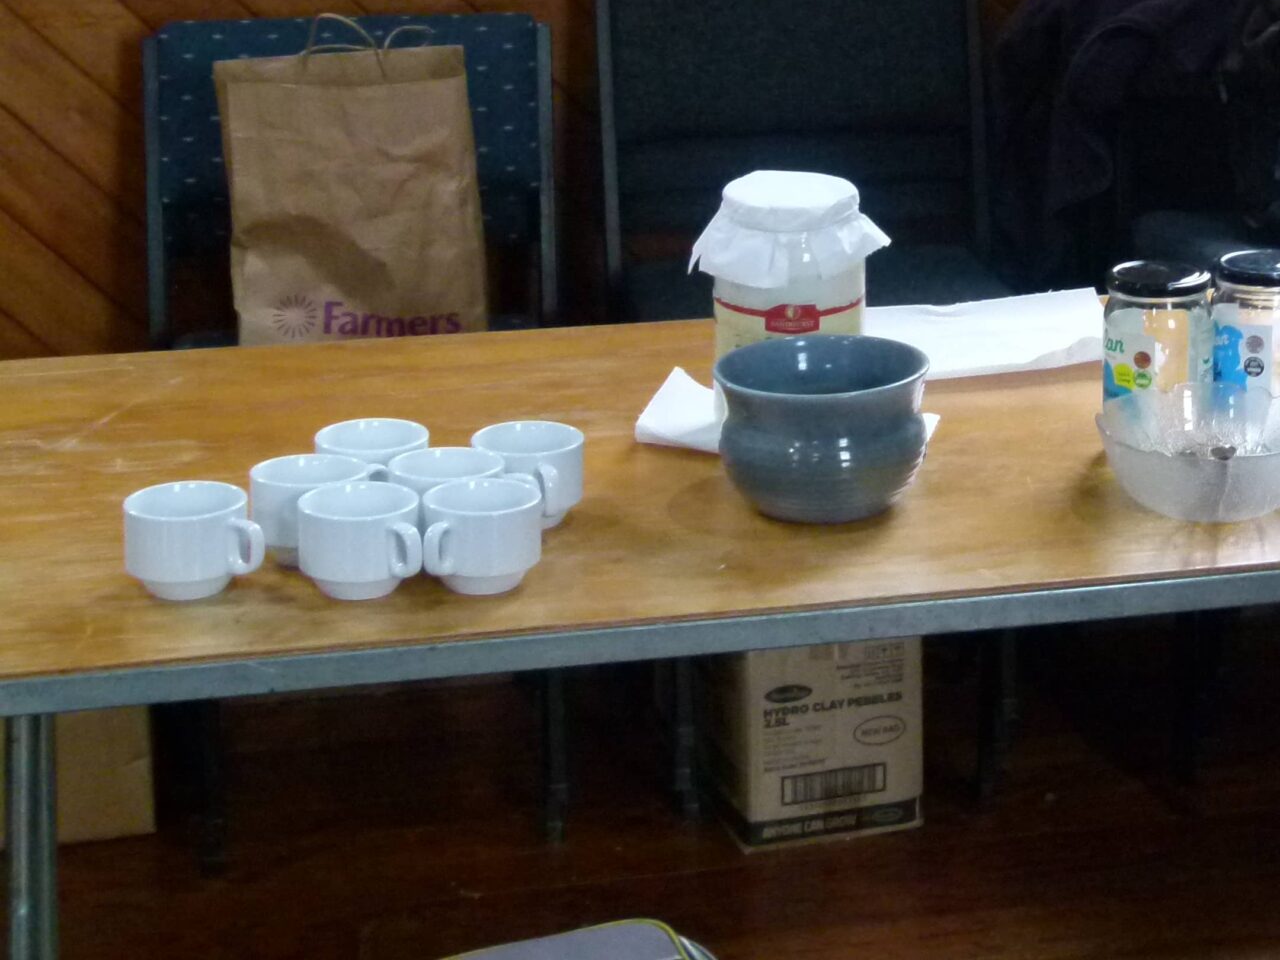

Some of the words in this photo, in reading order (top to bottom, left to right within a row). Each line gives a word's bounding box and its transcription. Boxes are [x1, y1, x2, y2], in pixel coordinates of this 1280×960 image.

[322, 300, 462, 337] Farmers
[763, 703, 809, 719] HYDRO
[812, 698, 845, 713] CLAY
[847, 691, 902, 708] PEBBLES
